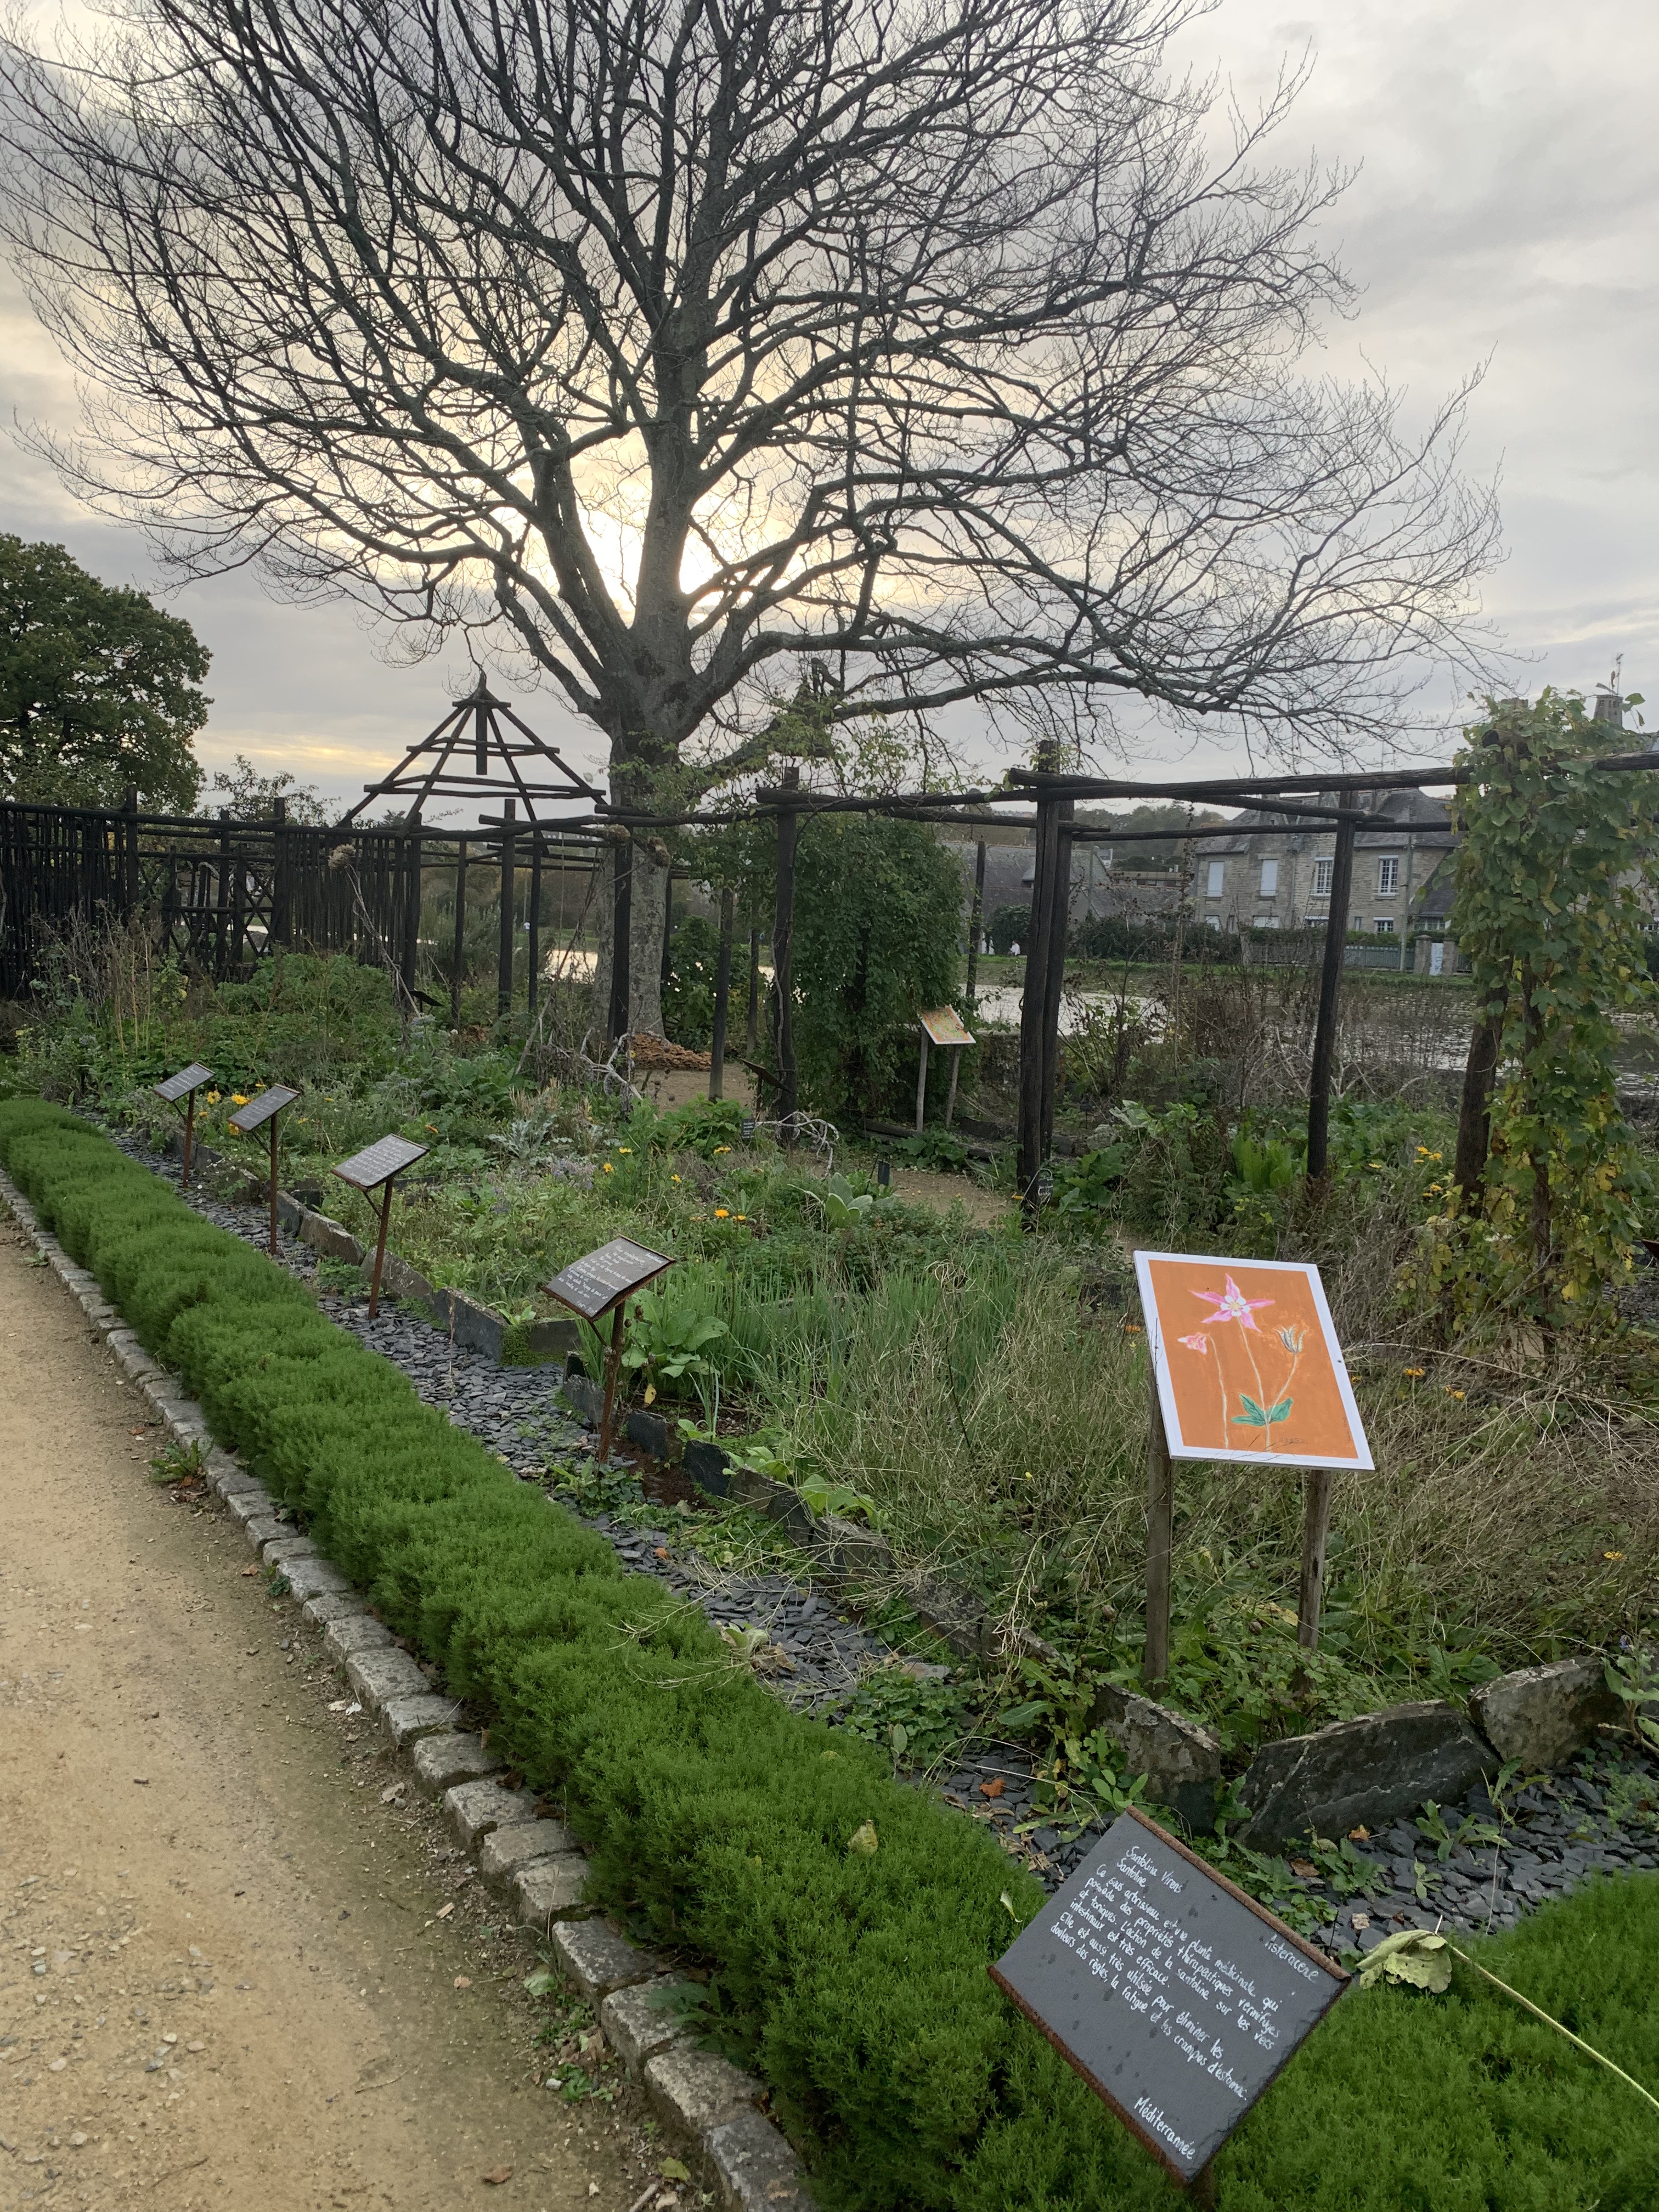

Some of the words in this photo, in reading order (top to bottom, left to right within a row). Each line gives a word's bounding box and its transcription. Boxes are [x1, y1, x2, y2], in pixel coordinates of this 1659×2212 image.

[1116, 1857, 1147, 1888] Santoline
[1126, 1846, 1158, 1877] Santolina
[1161, 1871, 1183, 1893] Virens
[1079, 1886, 1090, 1900] et
[1090, 1895, 1117, 1925] toniques.
[1120, 1920, 1148, 1949] L'action
[1151, 1946, 1162, 1960] de
[1164, 1955, 1173, 1970] la
[1175, 1968, 1210, 2000] santoline
[1216, 2001, 1233, 2016] sur
[1237, 2014, 1251, 2031] les
[1254, 2032, 1275, 2050] vers
[1096, 1863, 1107, 1878] Ce
[1108, 1877, 1125, 1892] sous
[1124, 1889, 1160, 1921] arbrisseau
[1163, 1920, 1178, 1930] est
[1174, 1928, 1188, 1942] une
[1186, 1939, 1213, 1960] plante
[1214, 1959, 1256, 1997] médicinale
[1262, 1996, 1283, 2012] qui
[1107, 1931, 1120, 1943] est
[1119, 1938, 1135, 1956] très
[1136, 1956, 1170, 1988] efficace.
[1119, 1899, 1133, 1916] des
[1133, 1917, 1174, 1948] propriétés
[1050, 1921, 1076, 1948] douleurs
[1076, 1943, 1089, 1960] des
[1110, 1974, 1119, 1989] la
[1121, 1985, 1148, 2013] fatigue
[1150, 2011, 1163, 2023] et
[1160, 2018, 1172, 2036] les
[1173, 2035, 1207, 2066] crampes
[1060, 1911, 1074, 1929] Elle
[1077, 1927, 1091, 1940] est
[1089, 1938, 1109, 1957] aussi
[1108, 1952, 1124, 1972] très
[1151, 1995, 1175, 2015] pour
[1210, 2038, 1224, 2059] les
